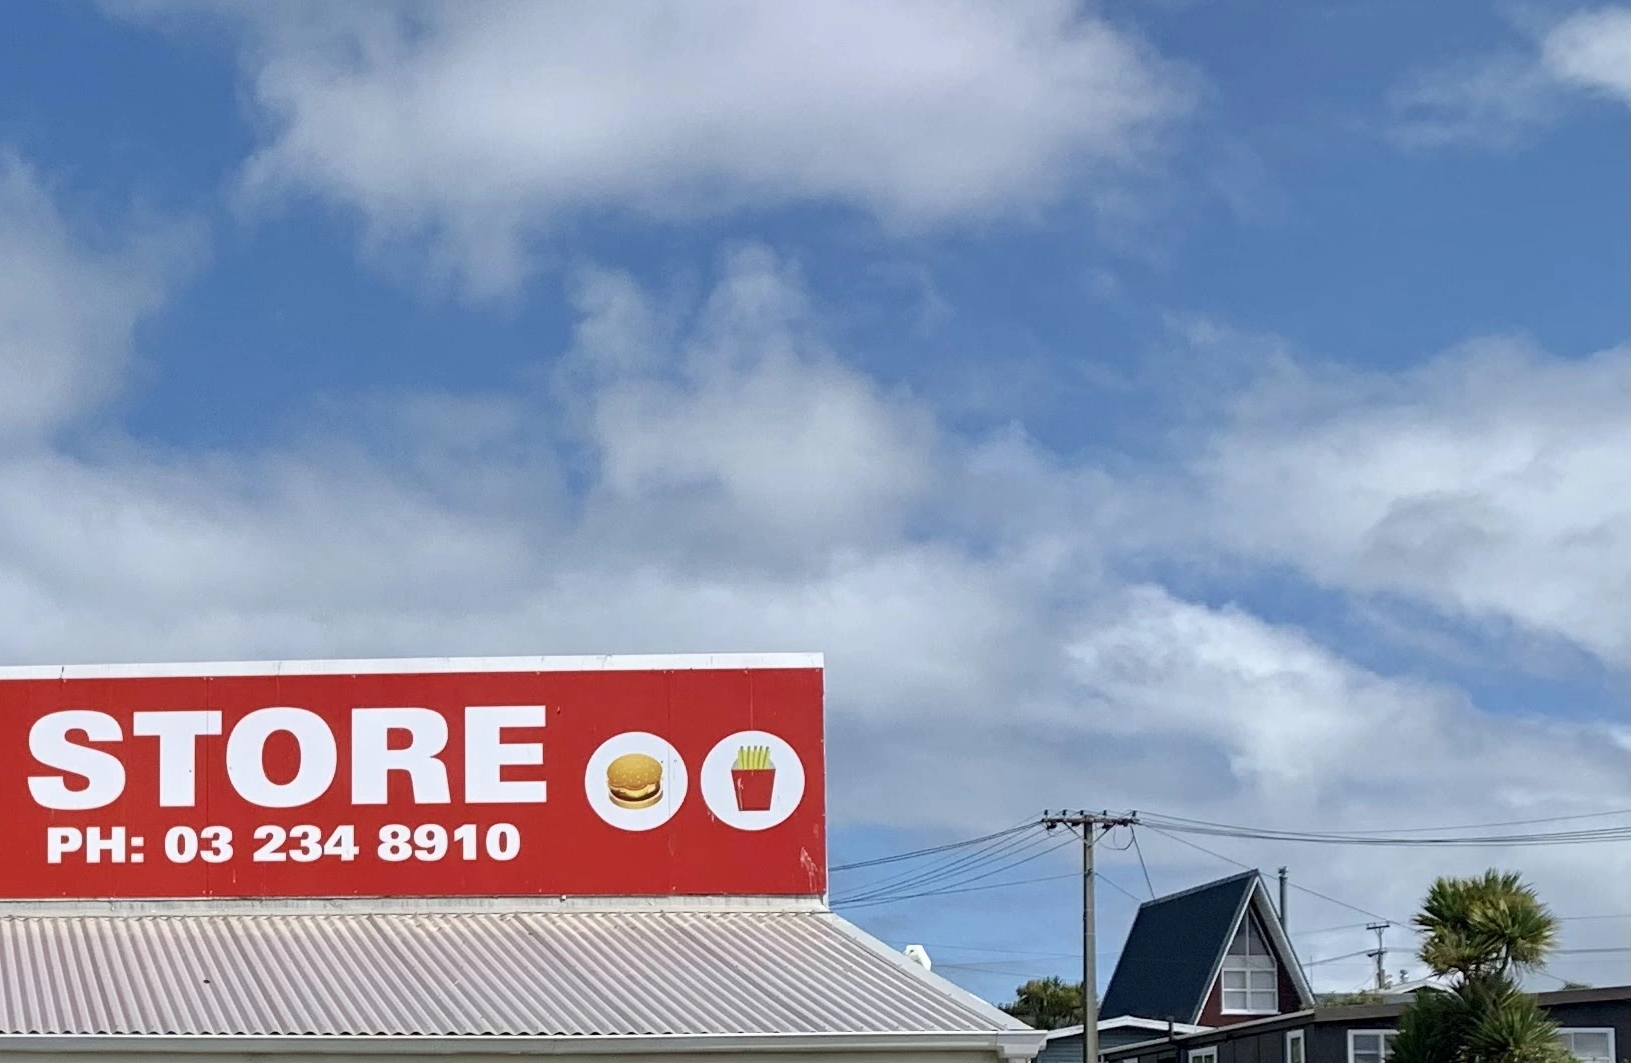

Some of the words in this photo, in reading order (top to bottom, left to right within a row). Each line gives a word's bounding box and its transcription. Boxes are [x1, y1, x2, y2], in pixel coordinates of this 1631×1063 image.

[27, 705, 547, 811] STORE
[47, 826, 144, 864] PH:
[164, 825, 234, 864] 03
[253, 824, 360, 863] 234
[377, 822, 521, 862] 8910
